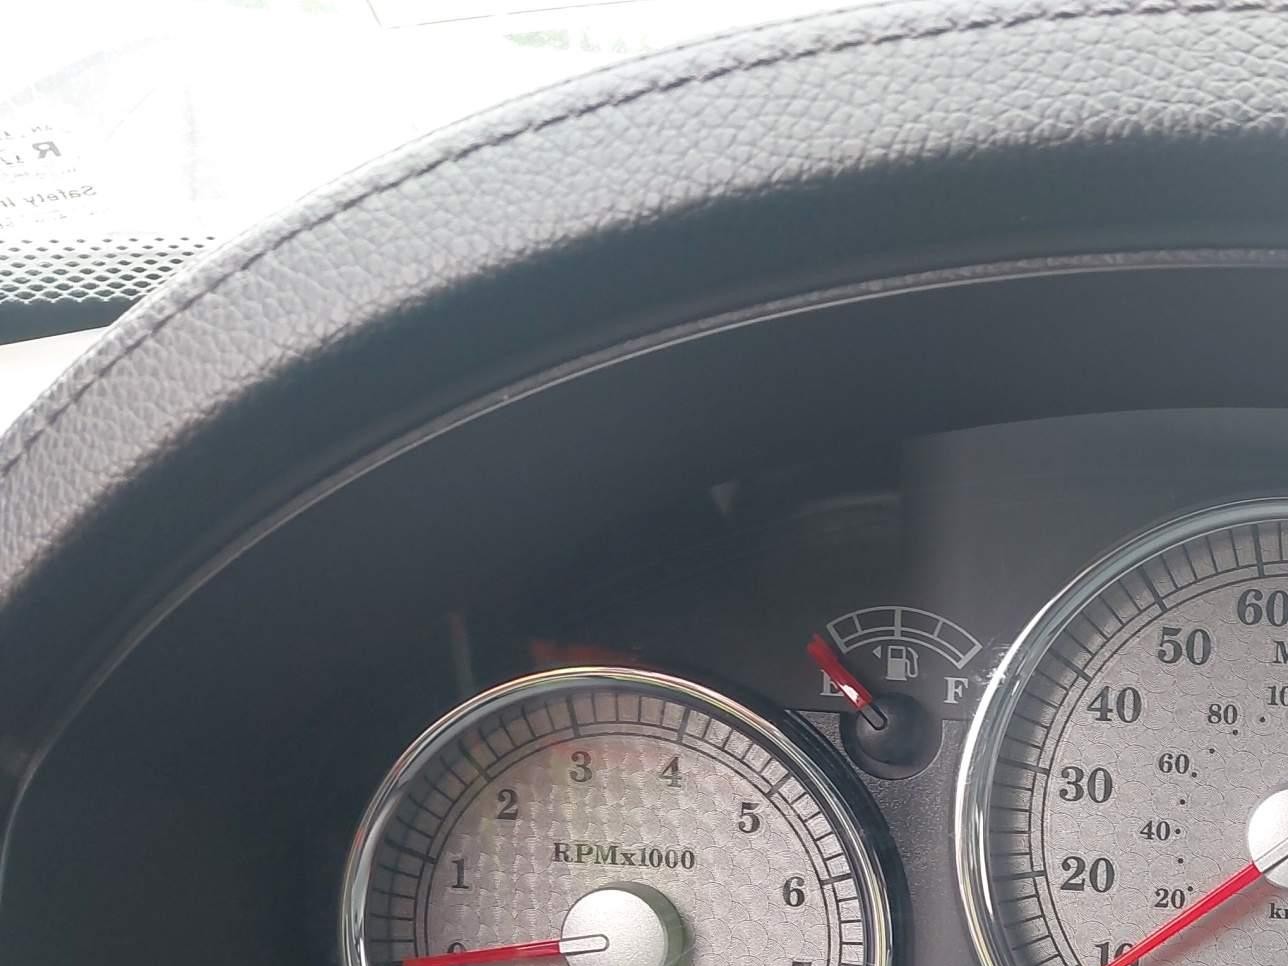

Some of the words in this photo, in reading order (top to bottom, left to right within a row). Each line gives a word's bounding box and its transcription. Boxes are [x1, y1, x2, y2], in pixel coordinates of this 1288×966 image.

[1157, 627, 1211, 665] 50
[944, 678, 968, 703] F
[1086, 686, 1141, 723] 40
[1208, 704, 1237, 724] 80
[570, 751, 592, 782] 3
[660, 757, 682, 787] 4
[1159, 753, 1189, 774] 60
[1060, 767, 1113, 803] 30
[496, 789, 518, 820] 2
[738, 802, 760, 833] 5
[1140, 821, 1170, 840] 40
[551, 843, 694, 869] RPMx1000
[452, 859, 469, 889] 1
[1060, 856, 1115, 893] 20
[783, 877, 804, 907] 6
[1155, 888, 1185, 909] 20
